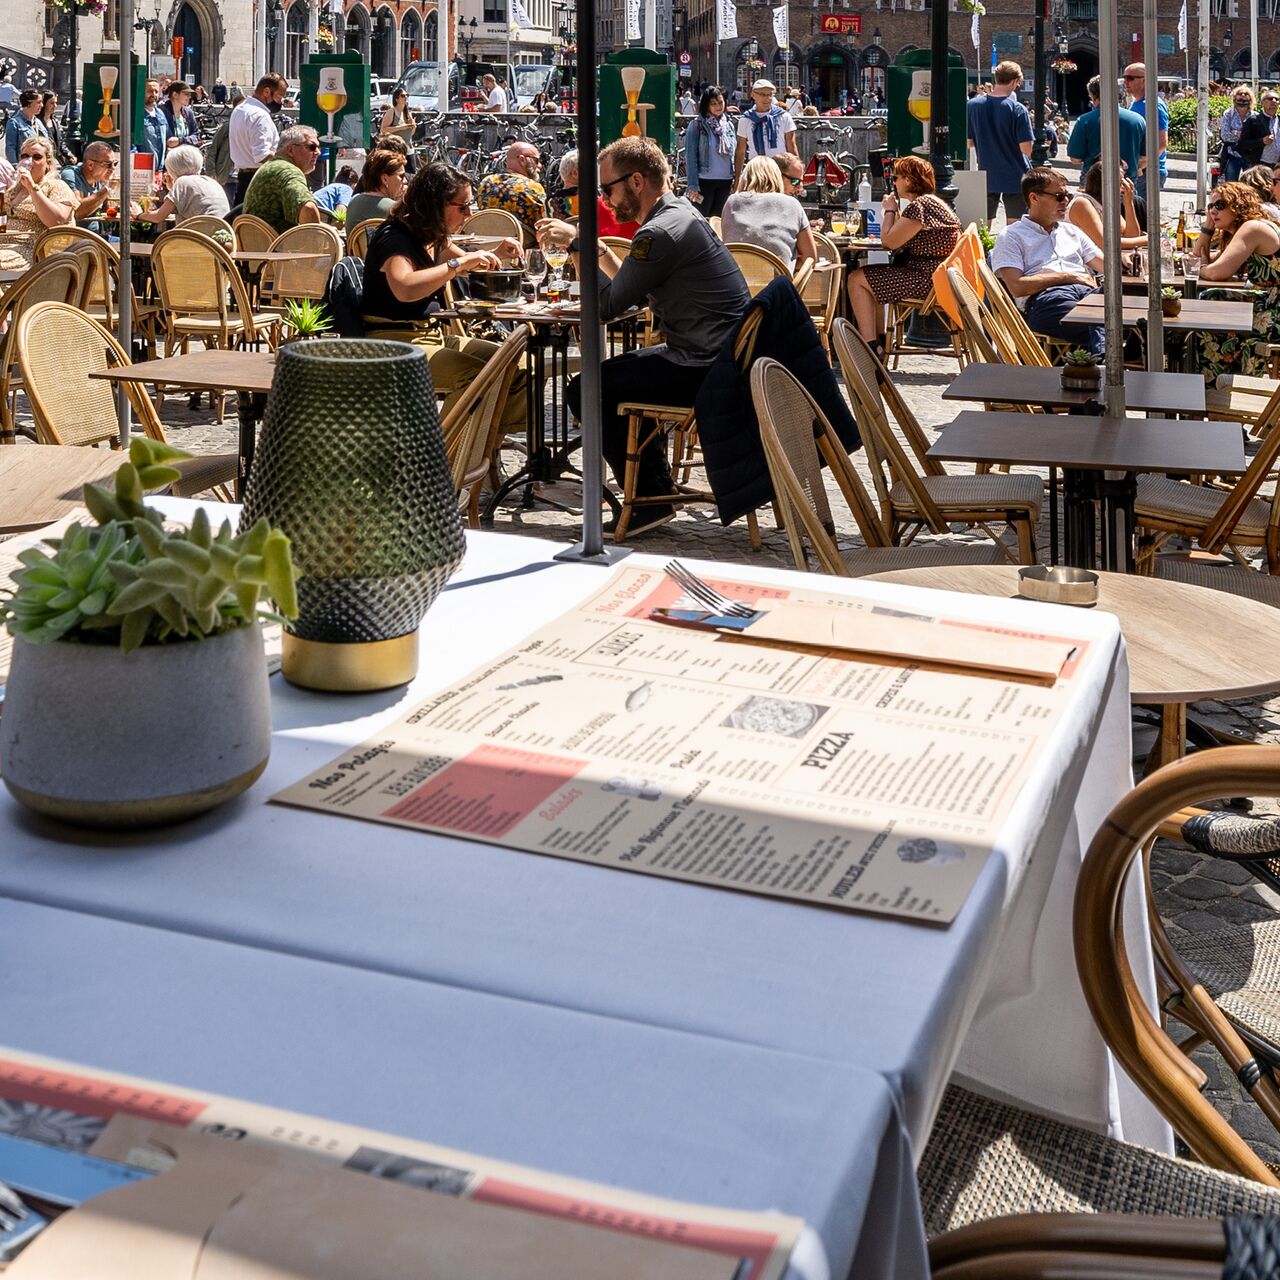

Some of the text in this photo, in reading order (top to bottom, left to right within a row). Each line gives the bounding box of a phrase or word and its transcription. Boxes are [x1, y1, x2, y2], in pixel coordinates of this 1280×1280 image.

[307, 739, 397, 790] Nos Potages
[801, 729, 855, 770] PIZZA
